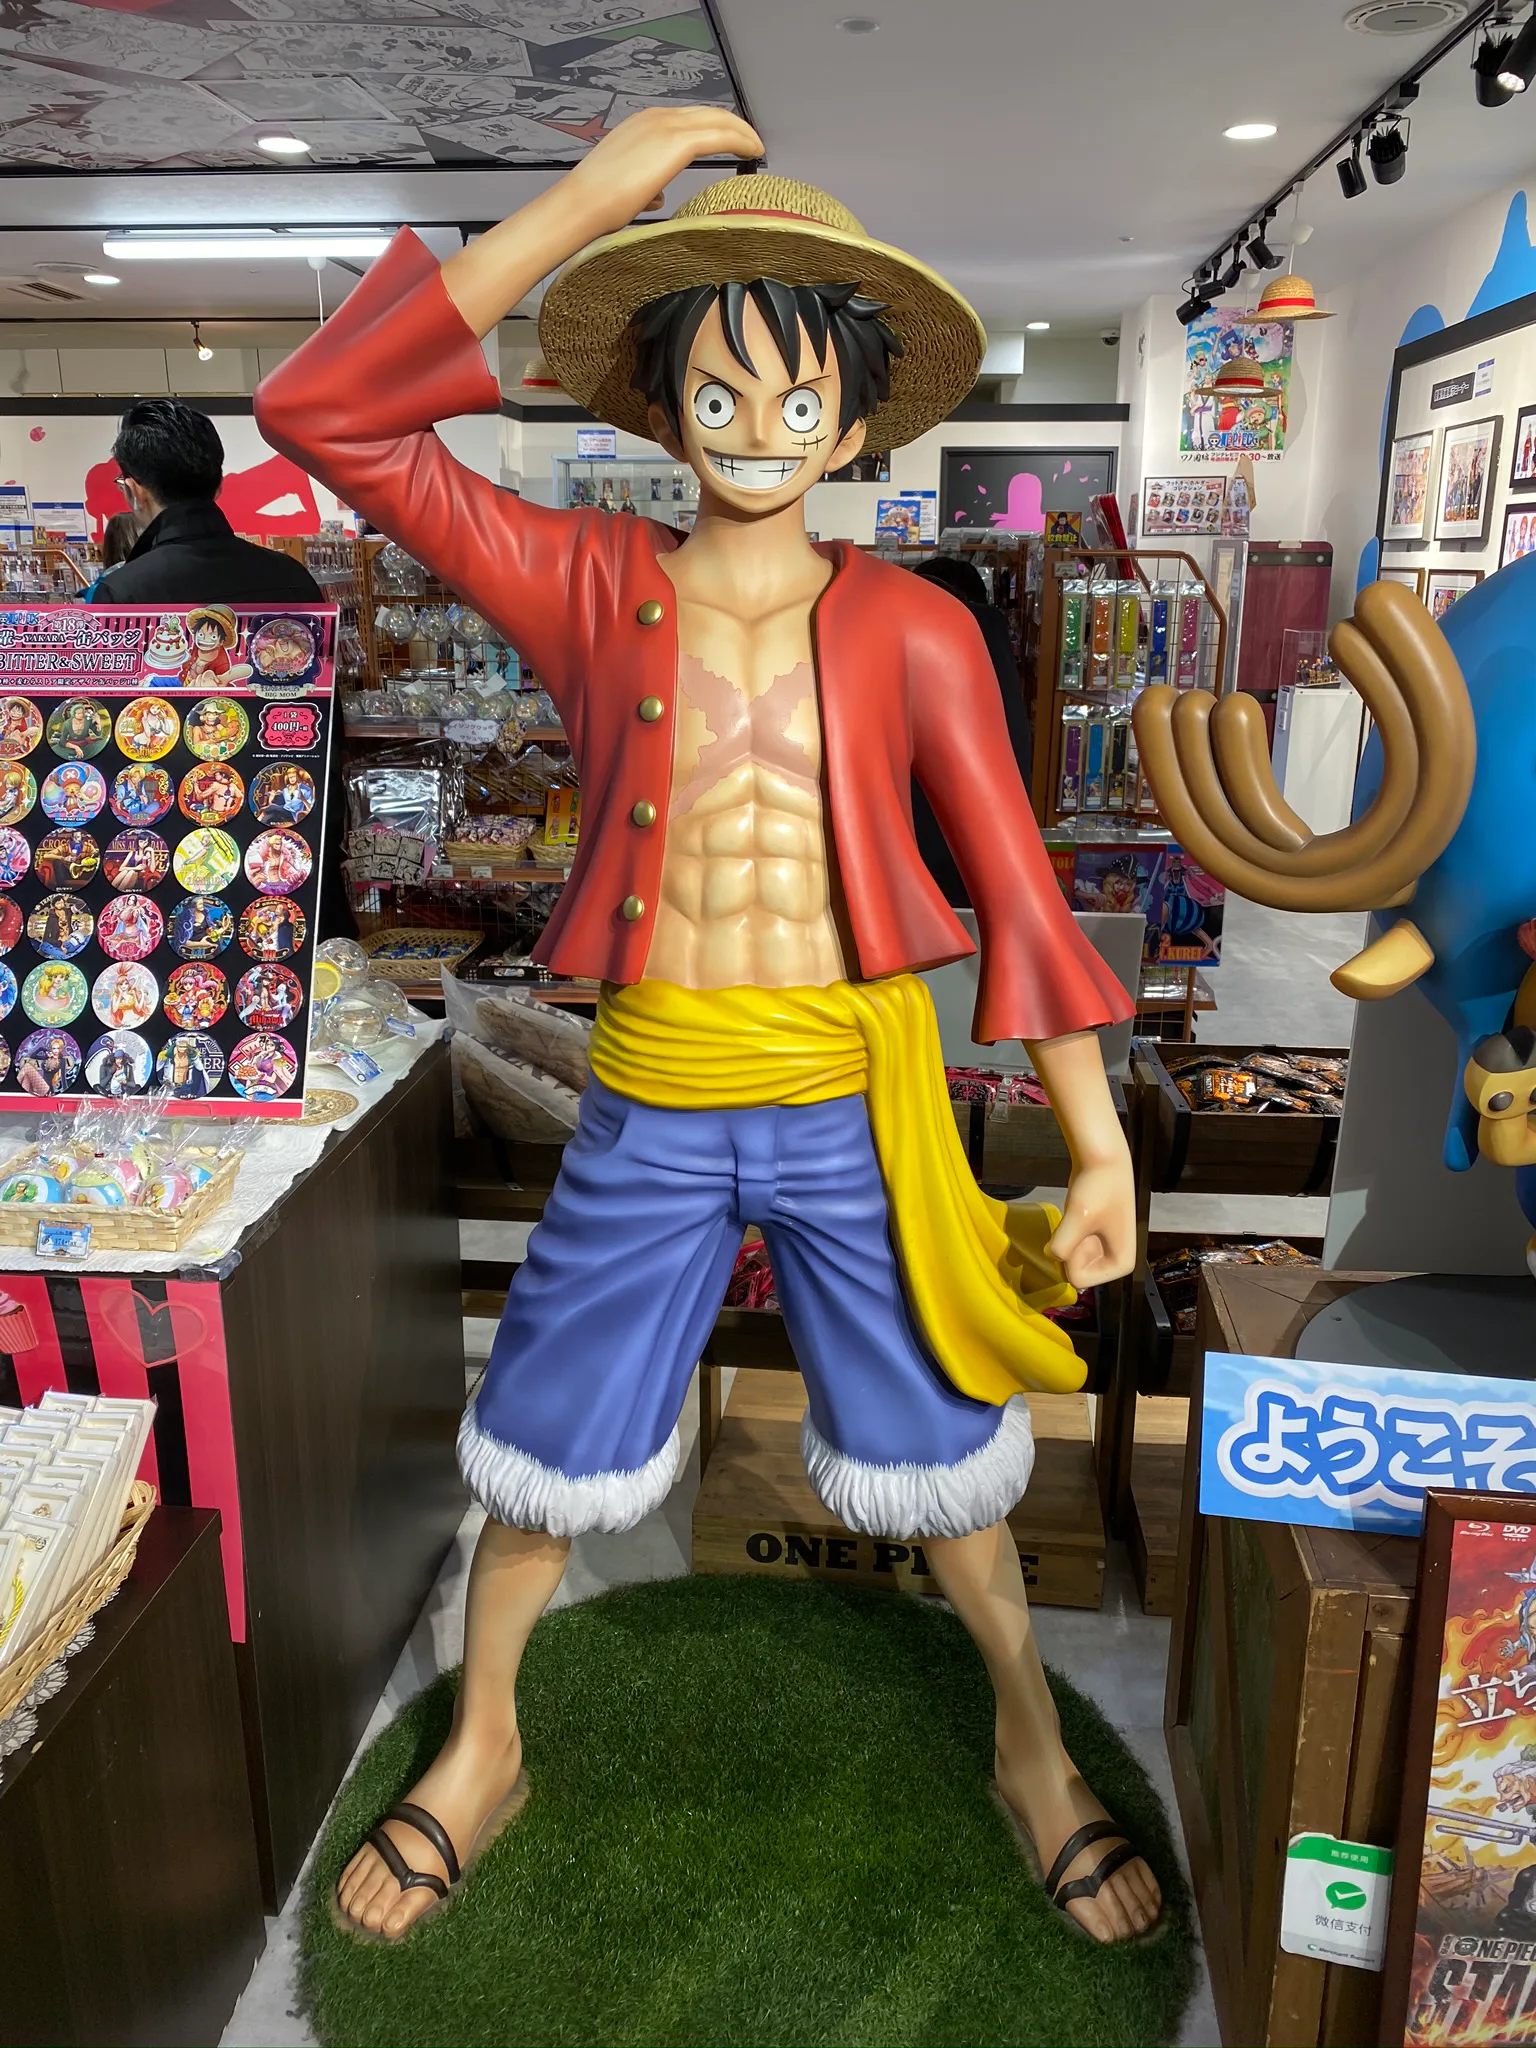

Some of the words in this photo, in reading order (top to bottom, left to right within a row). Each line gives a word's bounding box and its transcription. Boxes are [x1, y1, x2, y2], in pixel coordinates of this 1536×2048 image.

[1241, 1403, 1536, 1492] ようこそ
[1503, 1525, 1532, 1534] DVD
[746, 1533, 857, 1570] ONE
[1315, 1914, 1372, 1937] 微信支付
